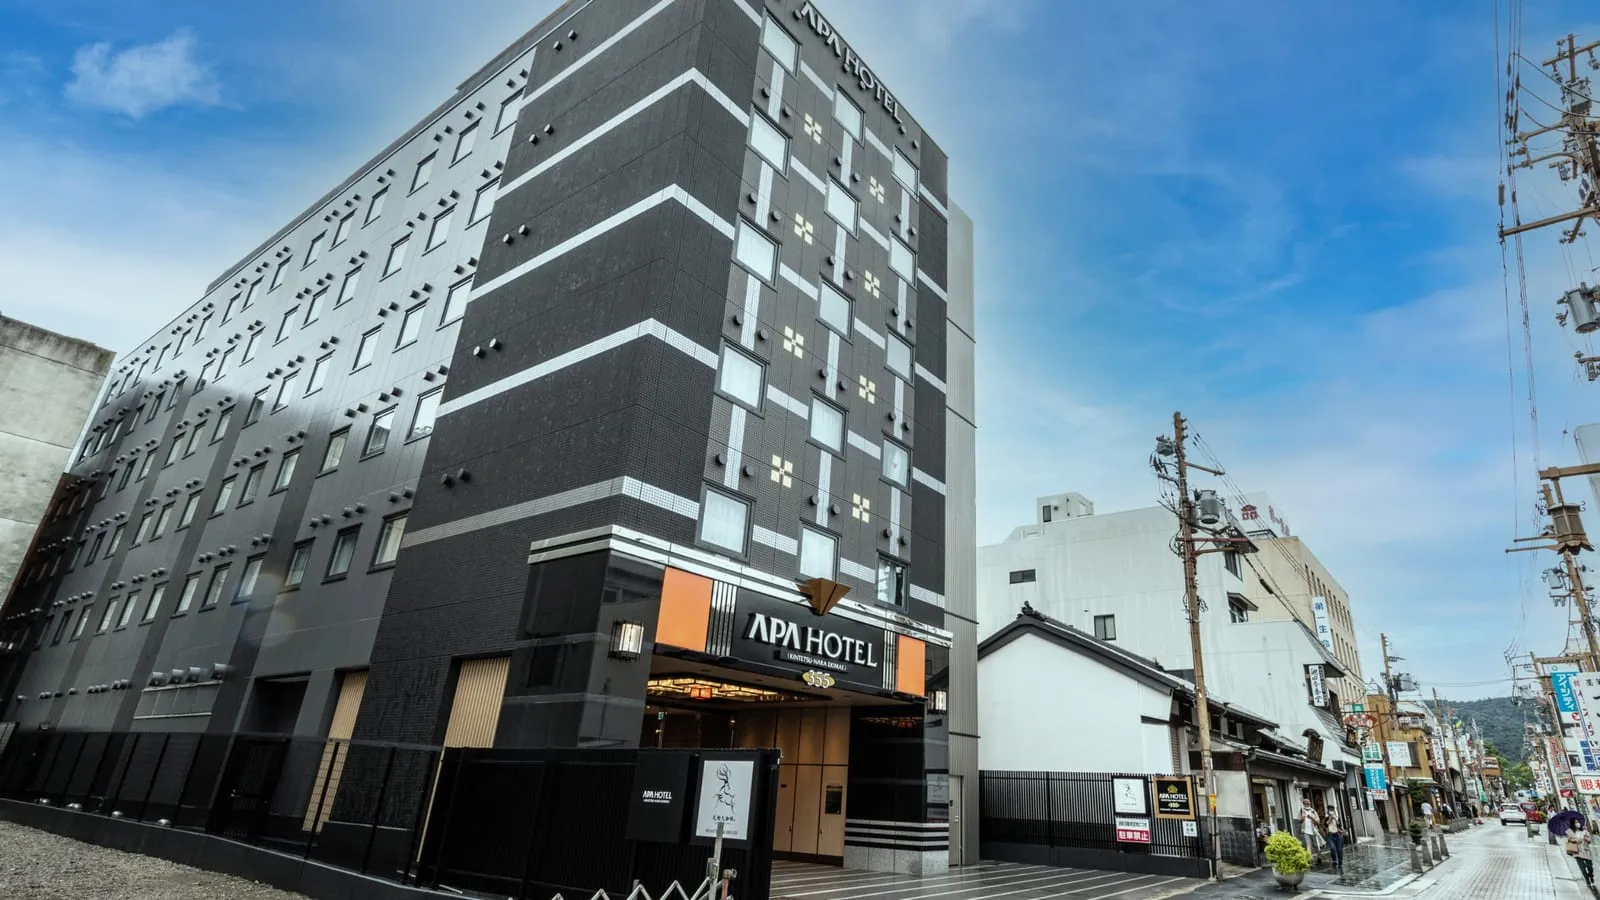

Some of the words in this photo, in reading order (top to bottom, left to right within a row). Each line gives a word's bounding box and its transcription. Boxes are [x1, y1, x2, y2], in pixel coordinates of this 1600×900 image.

[801, 2, 841, 57] APA
[845, 47, 902, 124] HOTEL
[748, 612, 800, 650] APA
[805, 626, 878, 668] HOTEL
[807, 669, 830, 689] 355
[643, 791, 654, 799] APA
[654, 791, 672, 800] HOTEL
[1118, 831, 1149, 841] 駐車禁止
